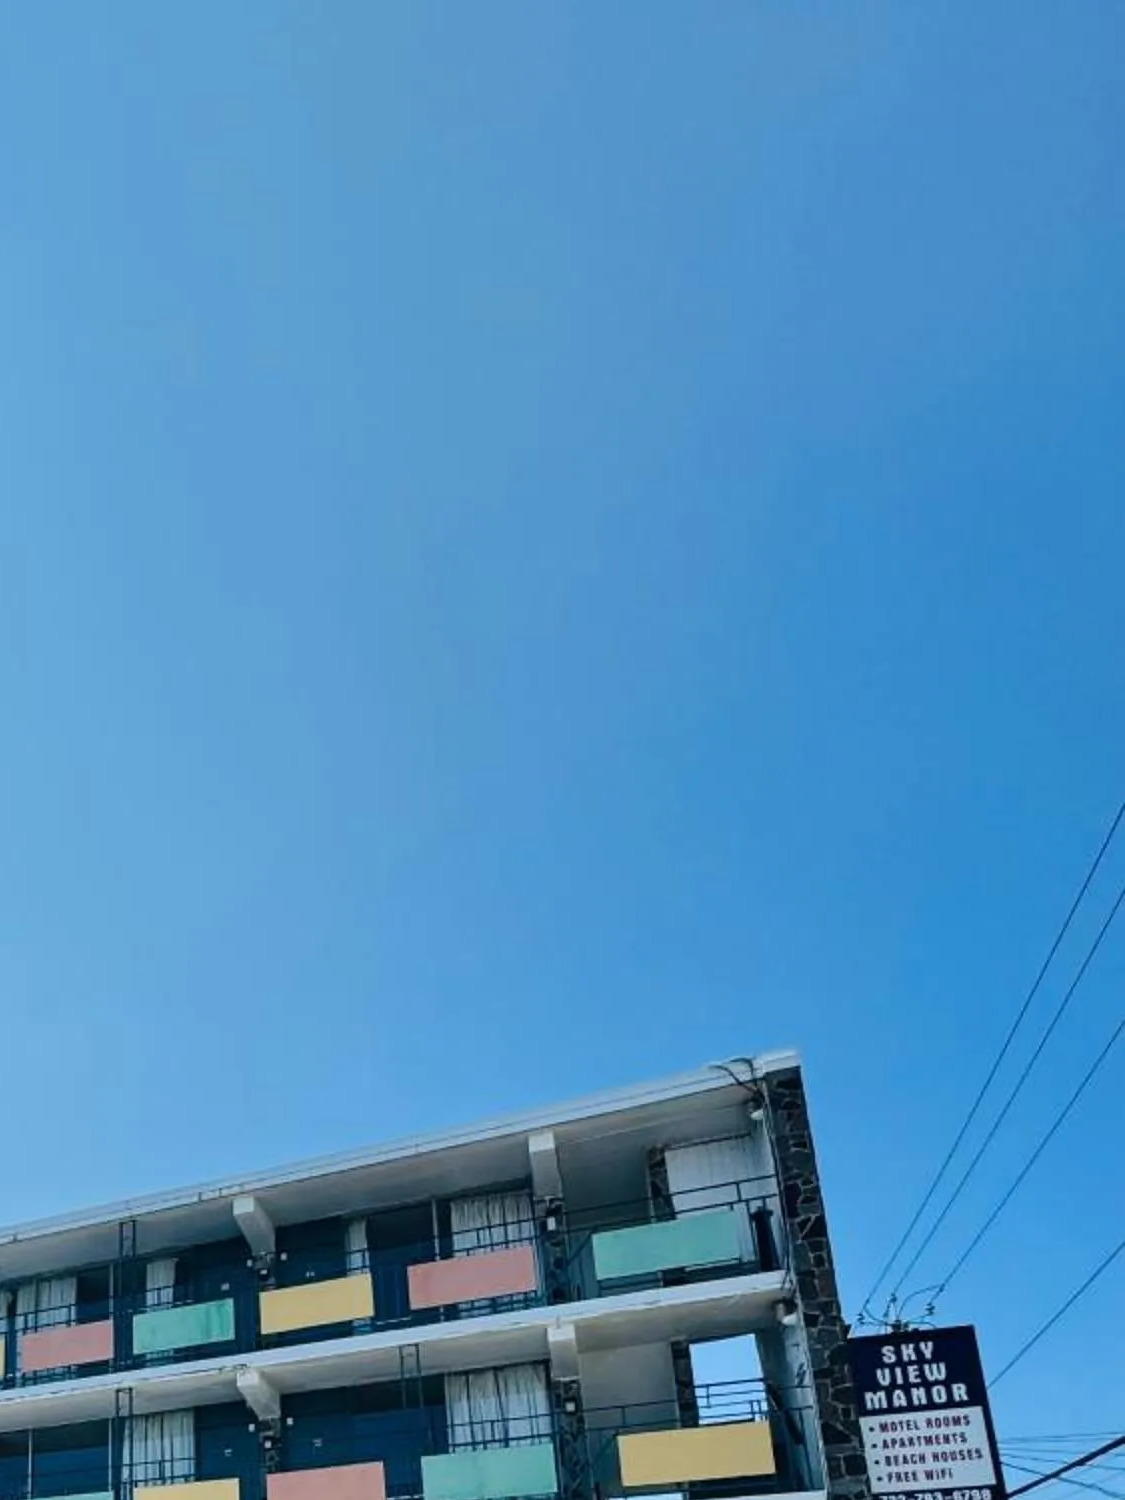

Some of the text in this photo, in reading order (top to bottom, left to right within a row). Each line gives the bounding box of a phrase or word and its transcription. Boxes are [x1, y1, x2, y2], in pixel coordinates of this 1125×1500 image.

[881, 1341, 933, 1364] SKY
[876, 1362, 947, 1387] VIEW
[864, 1383, 969, 1410] MANOR
[879, 1415, 971, 1433] MOTEL ROOMS
[882, 1432, 968, 1449] APARTMENTS
[885, 1448, 983, 1467] BEACH HOUSES
[887, 1471, 919, 1483] FREE
